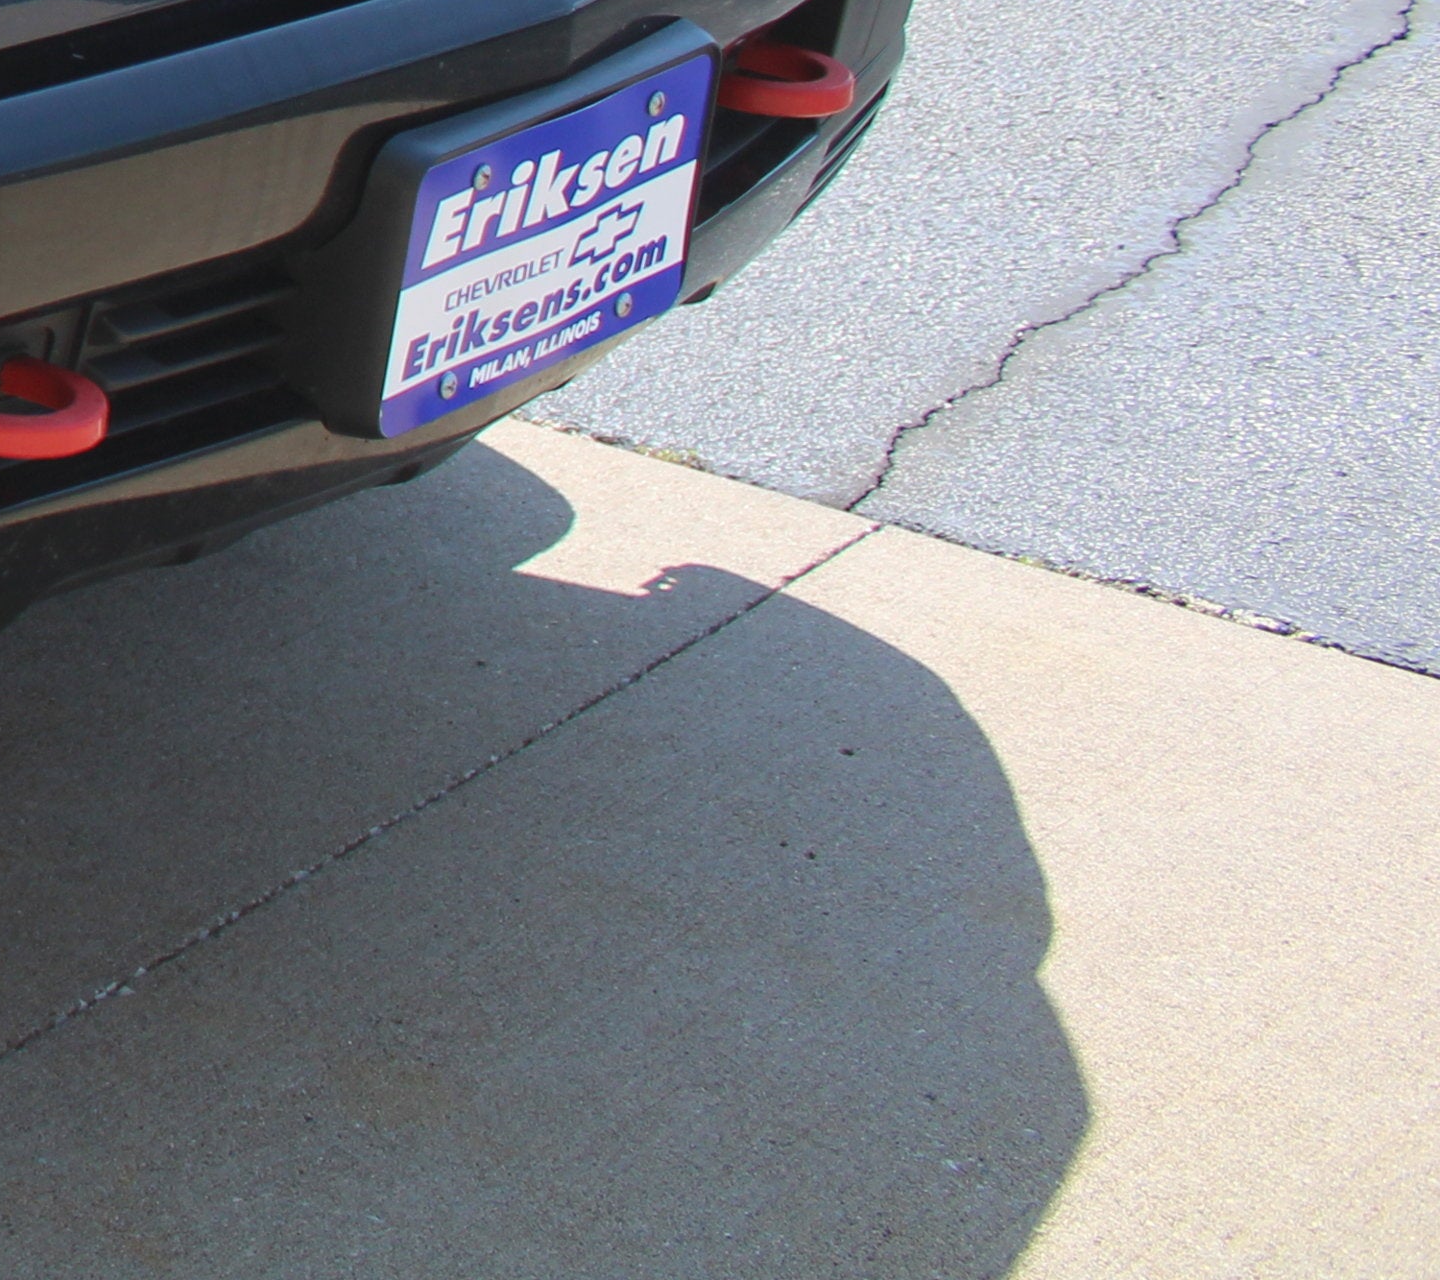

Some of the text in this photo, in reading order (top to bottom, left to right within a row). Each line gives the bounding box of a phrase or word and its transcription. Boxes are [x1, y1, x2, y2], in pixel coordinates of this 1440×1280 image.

[421, 113, 686, 271] Eriksen
[401, 233, 668, 383] Eriksens.com
[446, 249, 564, 312] CHEVROLET
[469, 311, 602, 389] MILAN, ILLINOIS
